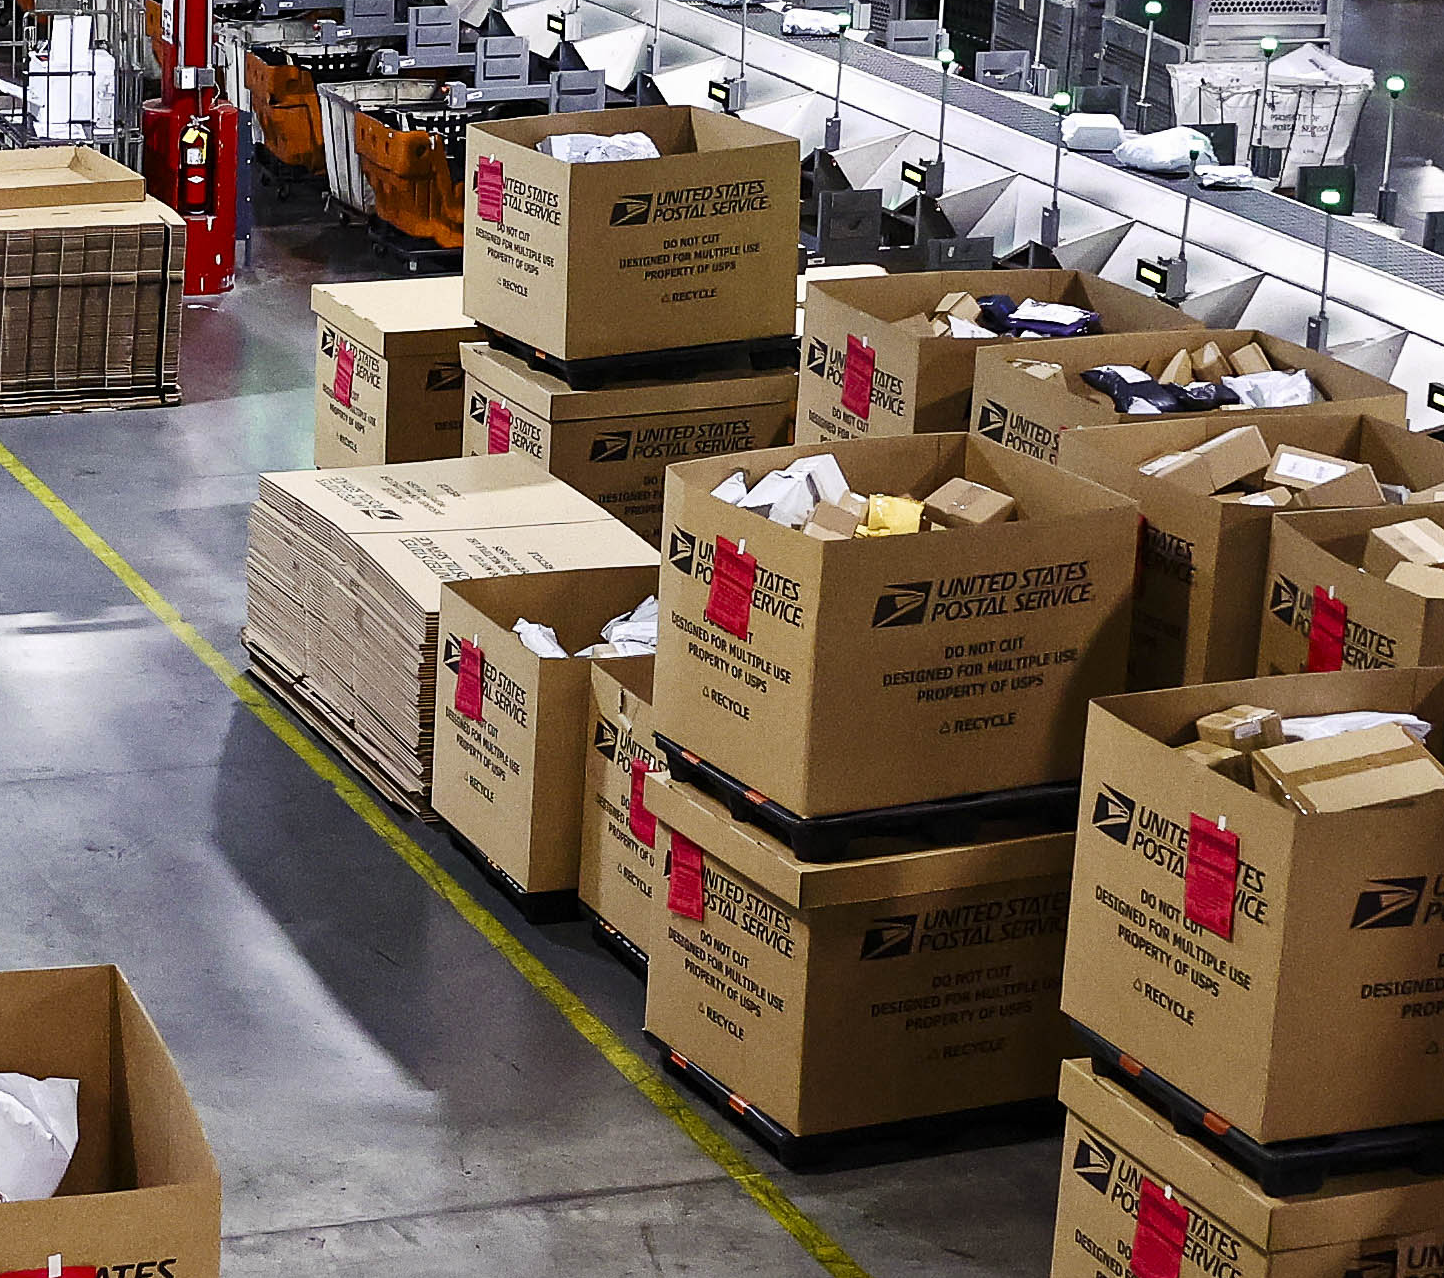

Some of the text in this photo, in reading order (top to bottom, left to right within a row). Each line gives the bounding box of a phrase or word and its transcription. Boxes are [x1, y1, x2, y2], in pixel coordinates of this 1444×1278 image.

[653, 179, 765, 206] UNITED STATES
[649, 195, 771, 224] POSTAL SERVICE
[661, 234, 720, 251] DO NOT CUT
[619, 244, 761, 269] DESIGNED FOR MULTIPLE USE
[644, 262, 735, 282] PROPERTY OF USPS
[672, 289, 717, 304] RECYCLE
